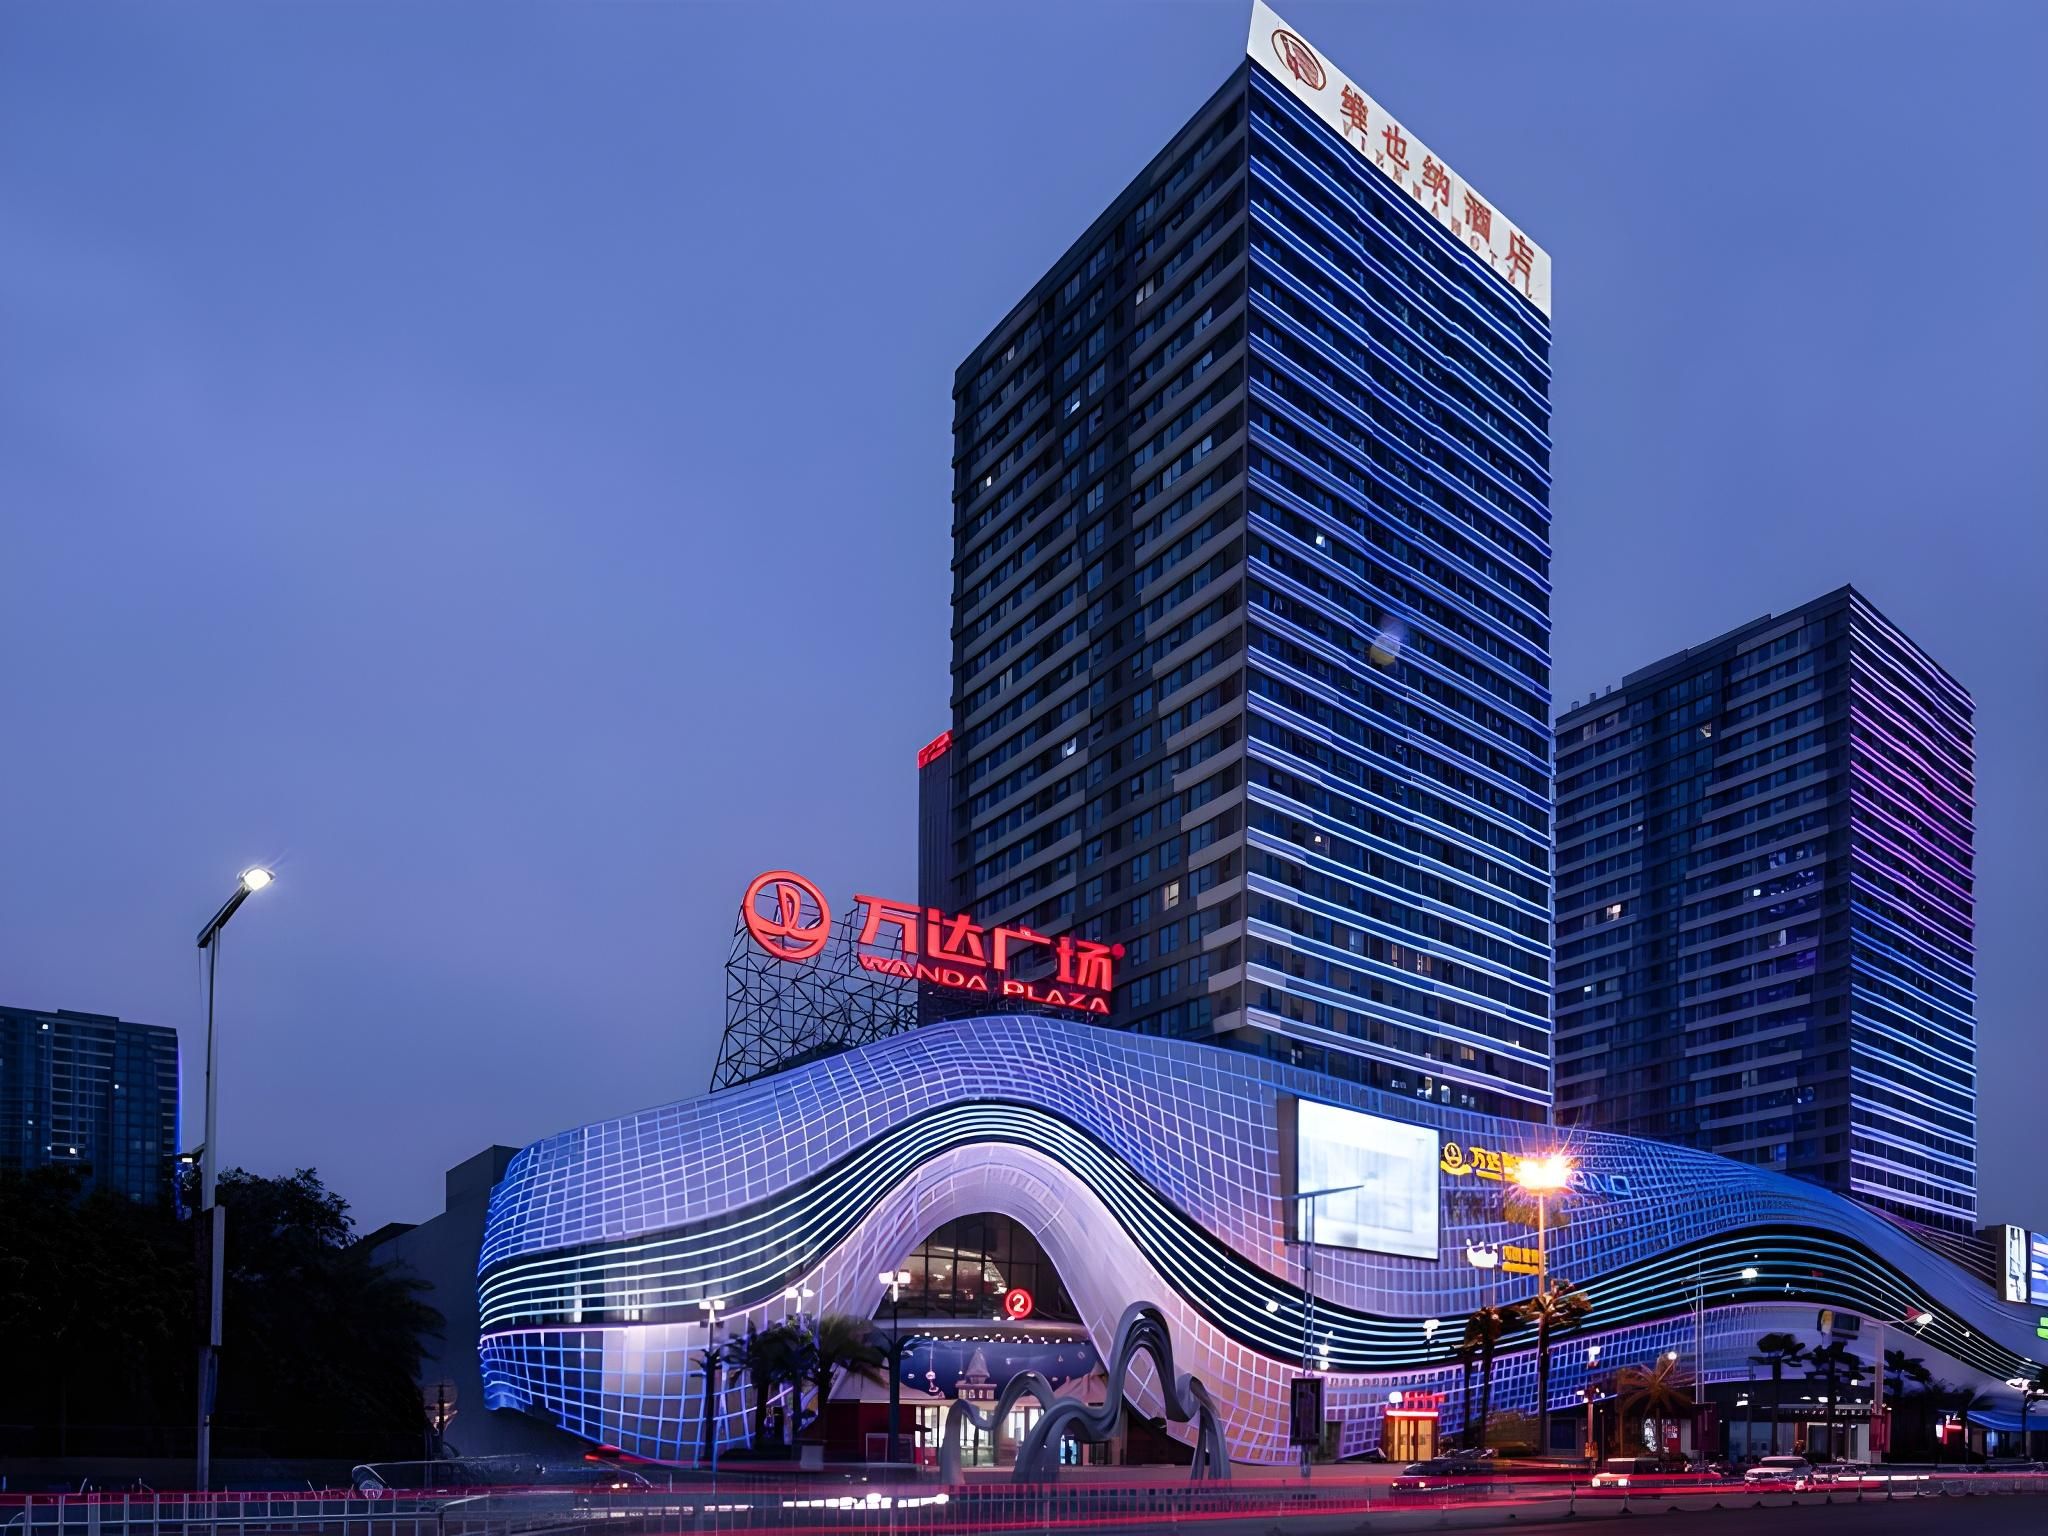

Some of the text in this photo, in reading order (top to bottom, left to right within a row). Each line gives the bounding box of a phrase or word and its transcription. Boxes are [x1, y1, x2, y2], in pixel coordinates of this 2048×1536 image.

[854, 894, 1112, 991] 万达广场
[858, 953, 1110, 1015] WANDA PLAZA
[1012, 1293, 1025, 1312] 2
